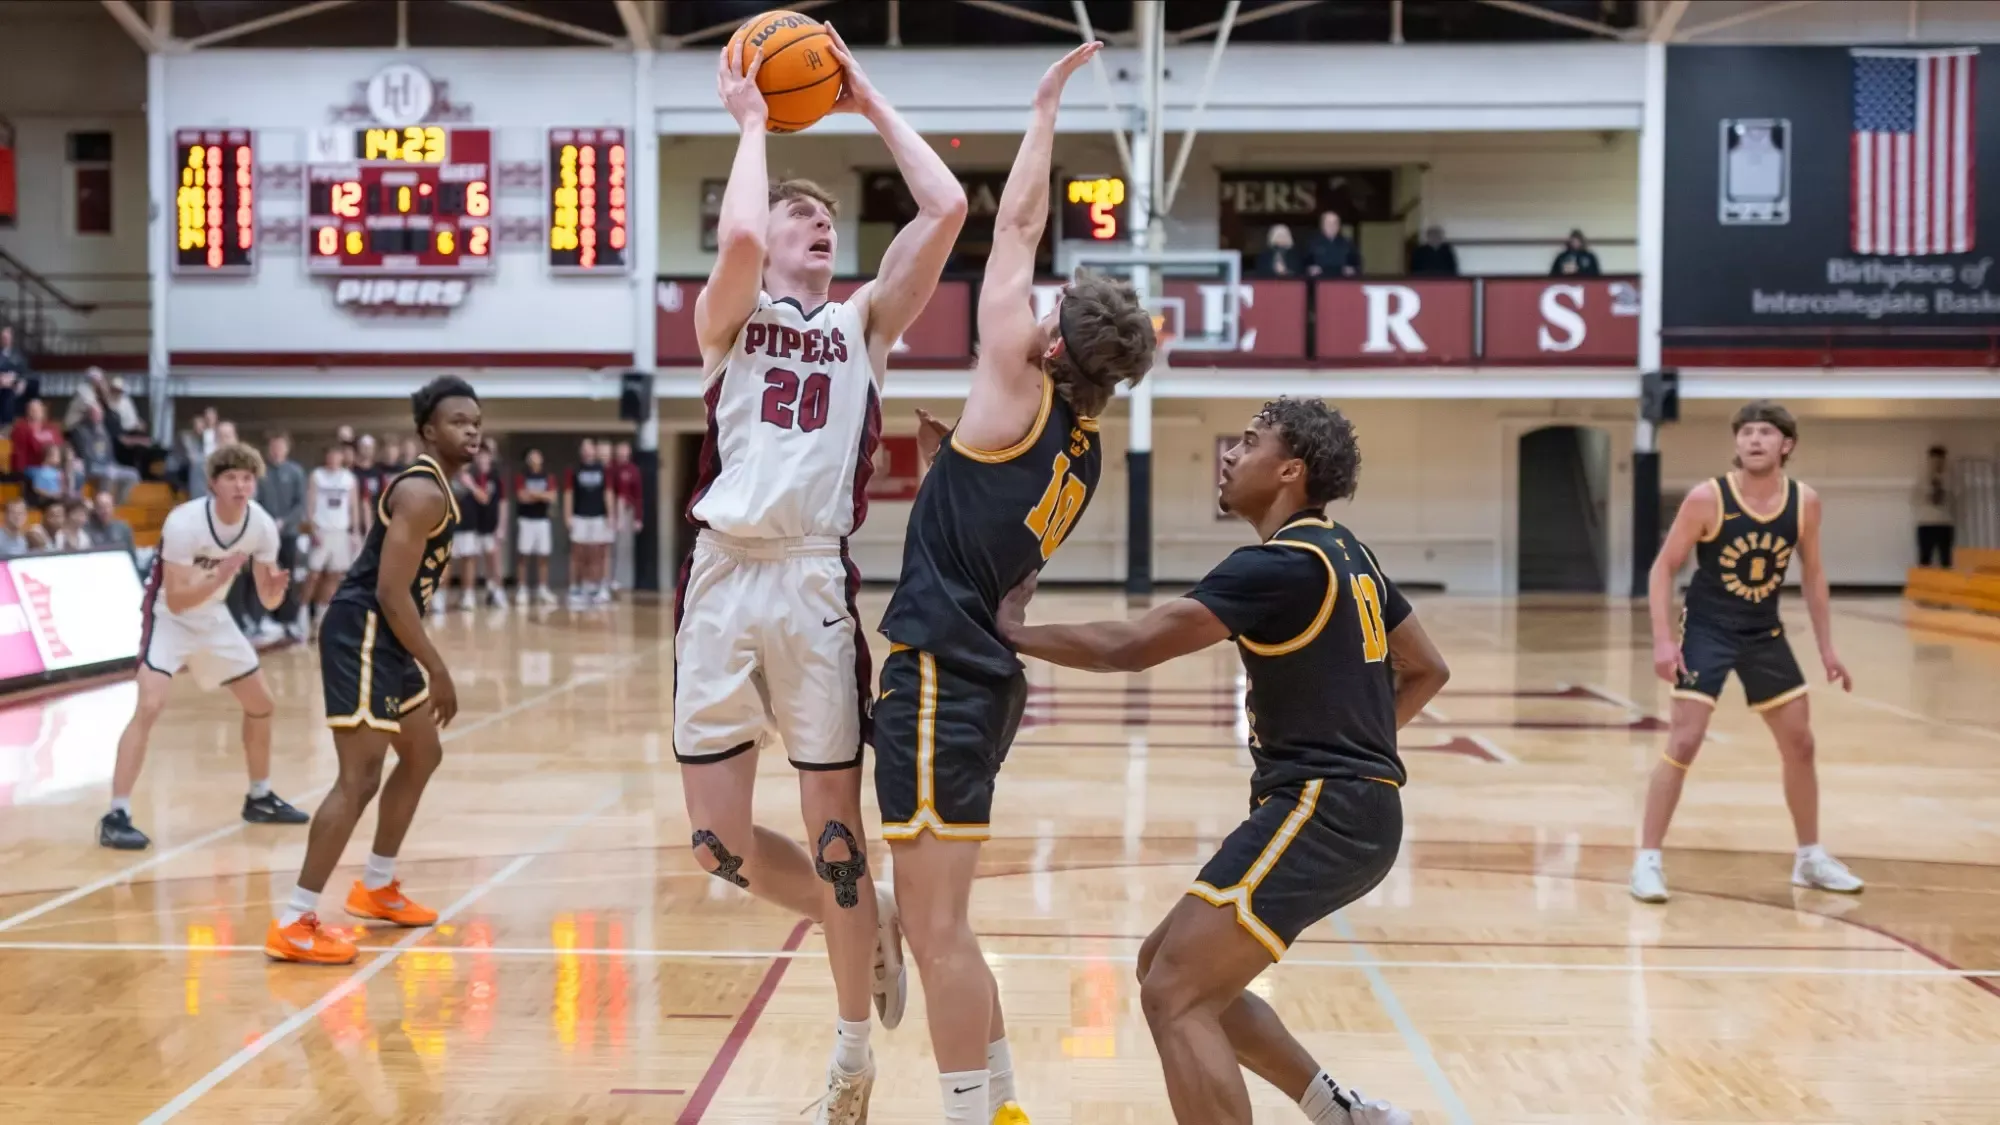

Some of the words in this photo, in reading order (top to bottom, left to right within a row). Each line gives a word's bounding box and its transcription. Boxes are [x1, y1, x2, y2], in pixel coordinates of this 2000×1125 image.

[331, 182, 362, 217] 12
[466, 181, 490, 217] 6
[1090, 202, 1116, 239] 5
[318, 226, 338, 255] 0
[469, 226, 489, 255] 2
[1826, 257, 1955, 290] Birthplace
[1959, 256, 1995, 289] of
[335, 279, 466, 306] PIPERS
[1752, 288, 1929, 320] Intercollegiate
[1361, 284, 1429, 353] R
[1537, 283, 1588, 353] S
[744, 322, 849, 366] PIPERS
[760, 366, 832, 434] 20
[1023, 450, 1087, 562] 10
